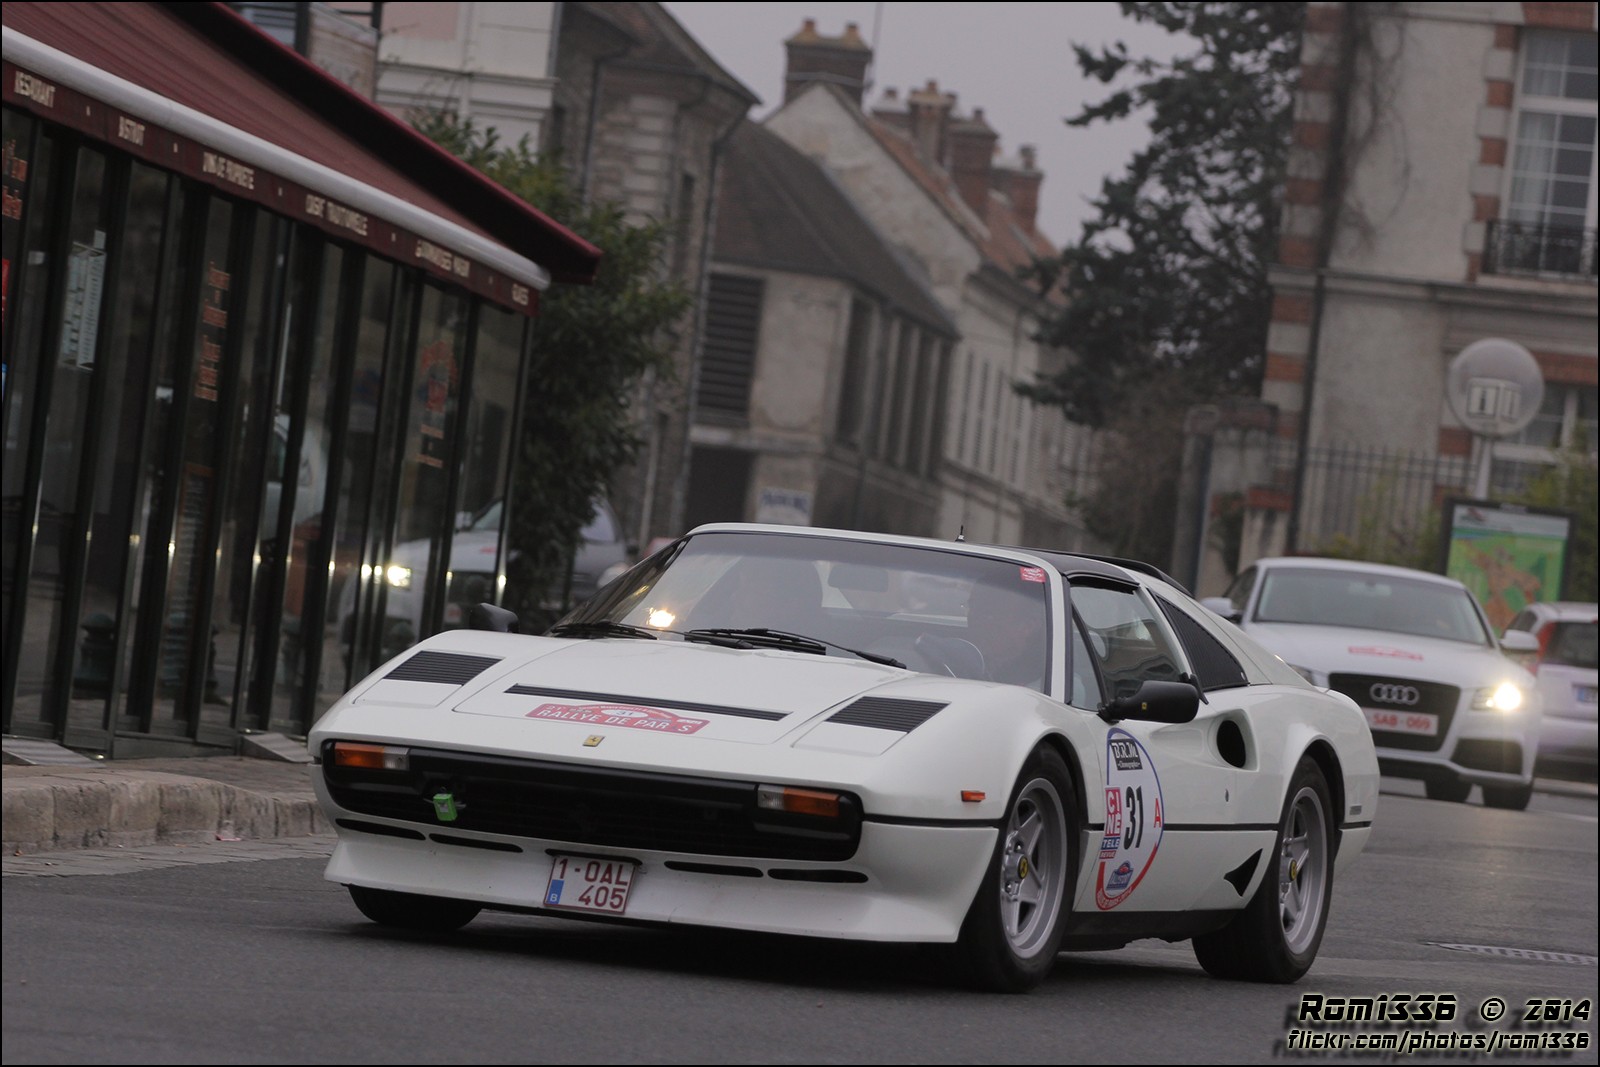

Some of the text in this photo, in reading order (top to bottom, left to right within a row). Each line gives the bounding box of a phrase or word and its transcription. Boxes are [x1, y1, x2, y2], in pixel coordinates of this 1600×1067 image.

[536, 709, 602, 722] RALLYE
[604, 716, 631, 726] DE
[1124, 785, 1144, 850] 31
[1154, 798, 1162, 828] A
[550, 893, 558, 902] B
[578, 885, 625, 909] 405
